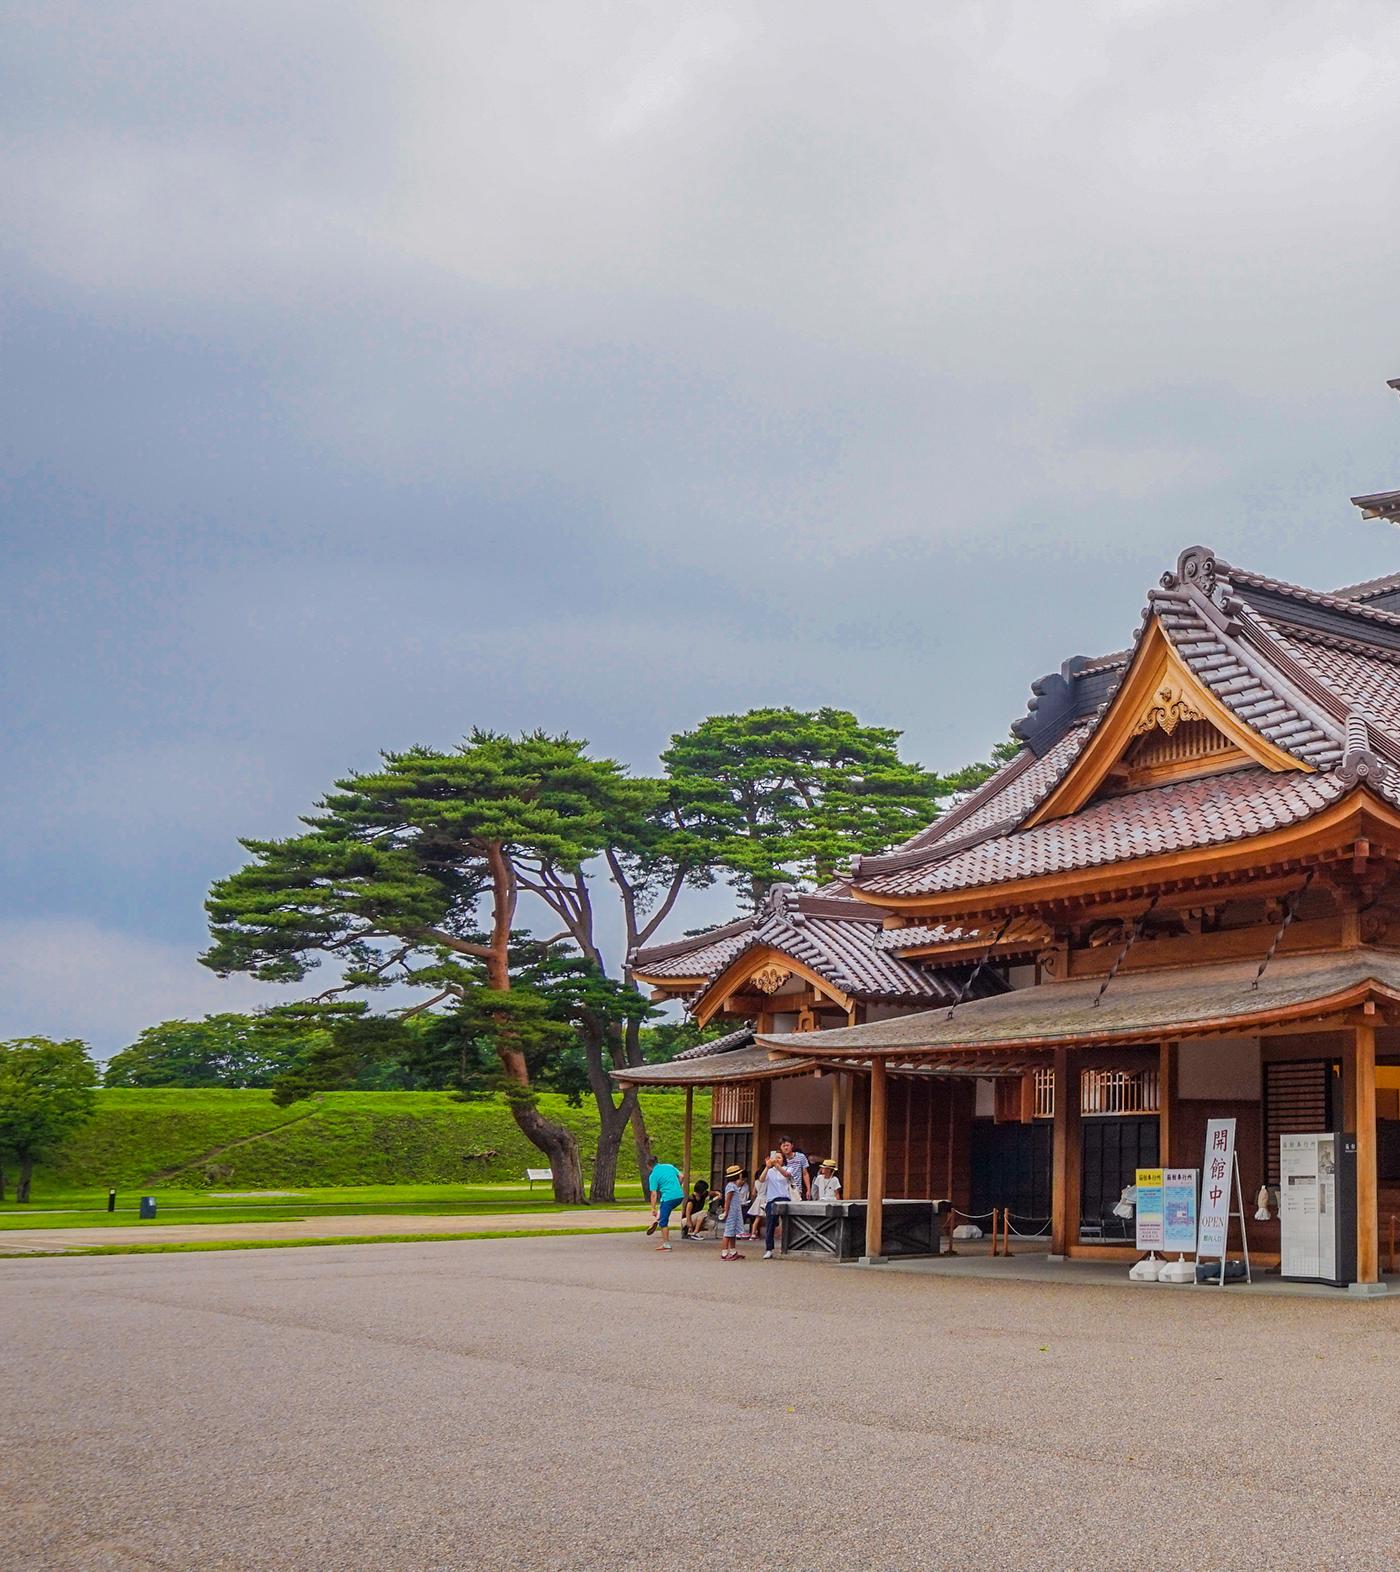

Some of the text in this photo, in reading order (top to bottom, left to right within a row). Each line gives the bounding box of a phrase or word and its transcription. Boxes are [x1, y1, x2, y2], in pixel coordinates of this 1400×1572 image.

[1209, 1129, 1228, 1209] 開館中
[1201, 1216, 1225, 1228] OPEN
